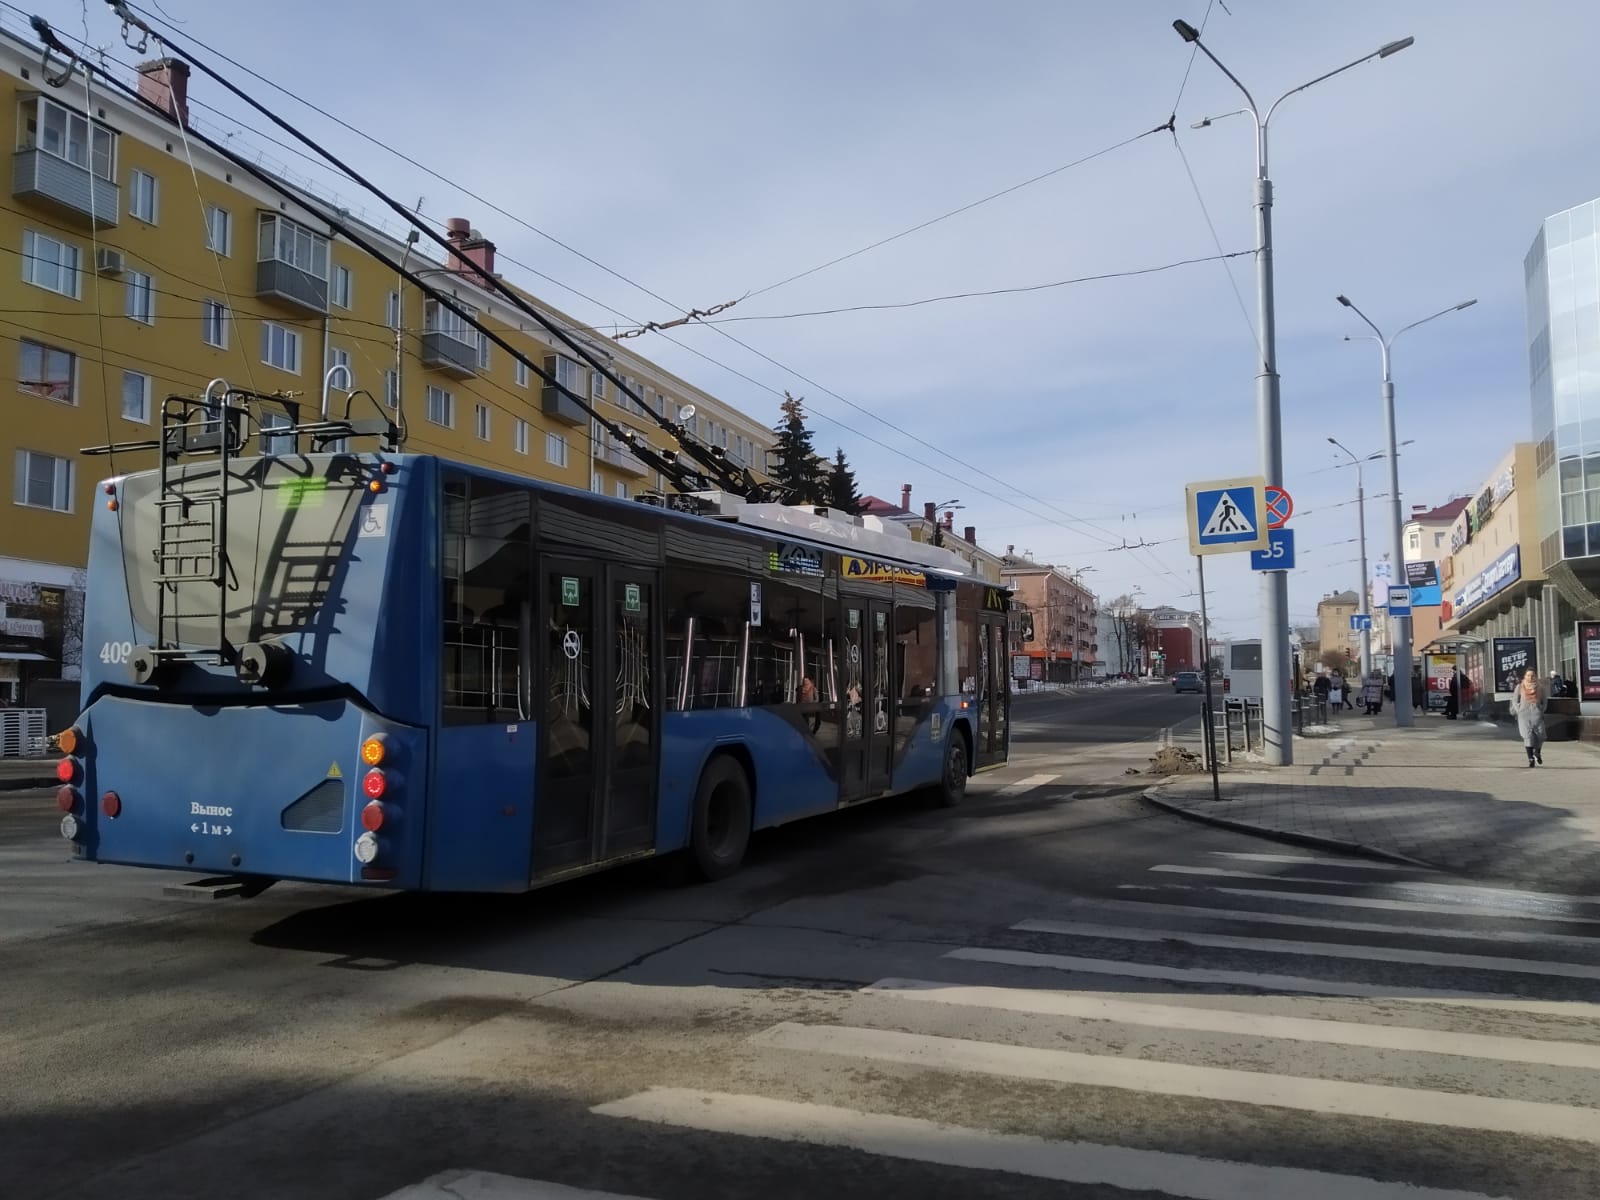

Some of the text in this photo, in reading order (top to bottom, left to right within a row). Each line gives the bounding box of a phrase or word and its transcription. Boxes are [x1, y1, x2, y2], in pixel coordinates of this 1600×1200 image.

[100, 642, 132, 664] 409
[1501, 652, 1528, 664] ПЕТЕР
[1502, 659, 1528, 672] БУРГ
[191, 802, 233, 817] Вынос
[202, 822, 222, 835] 1 м
